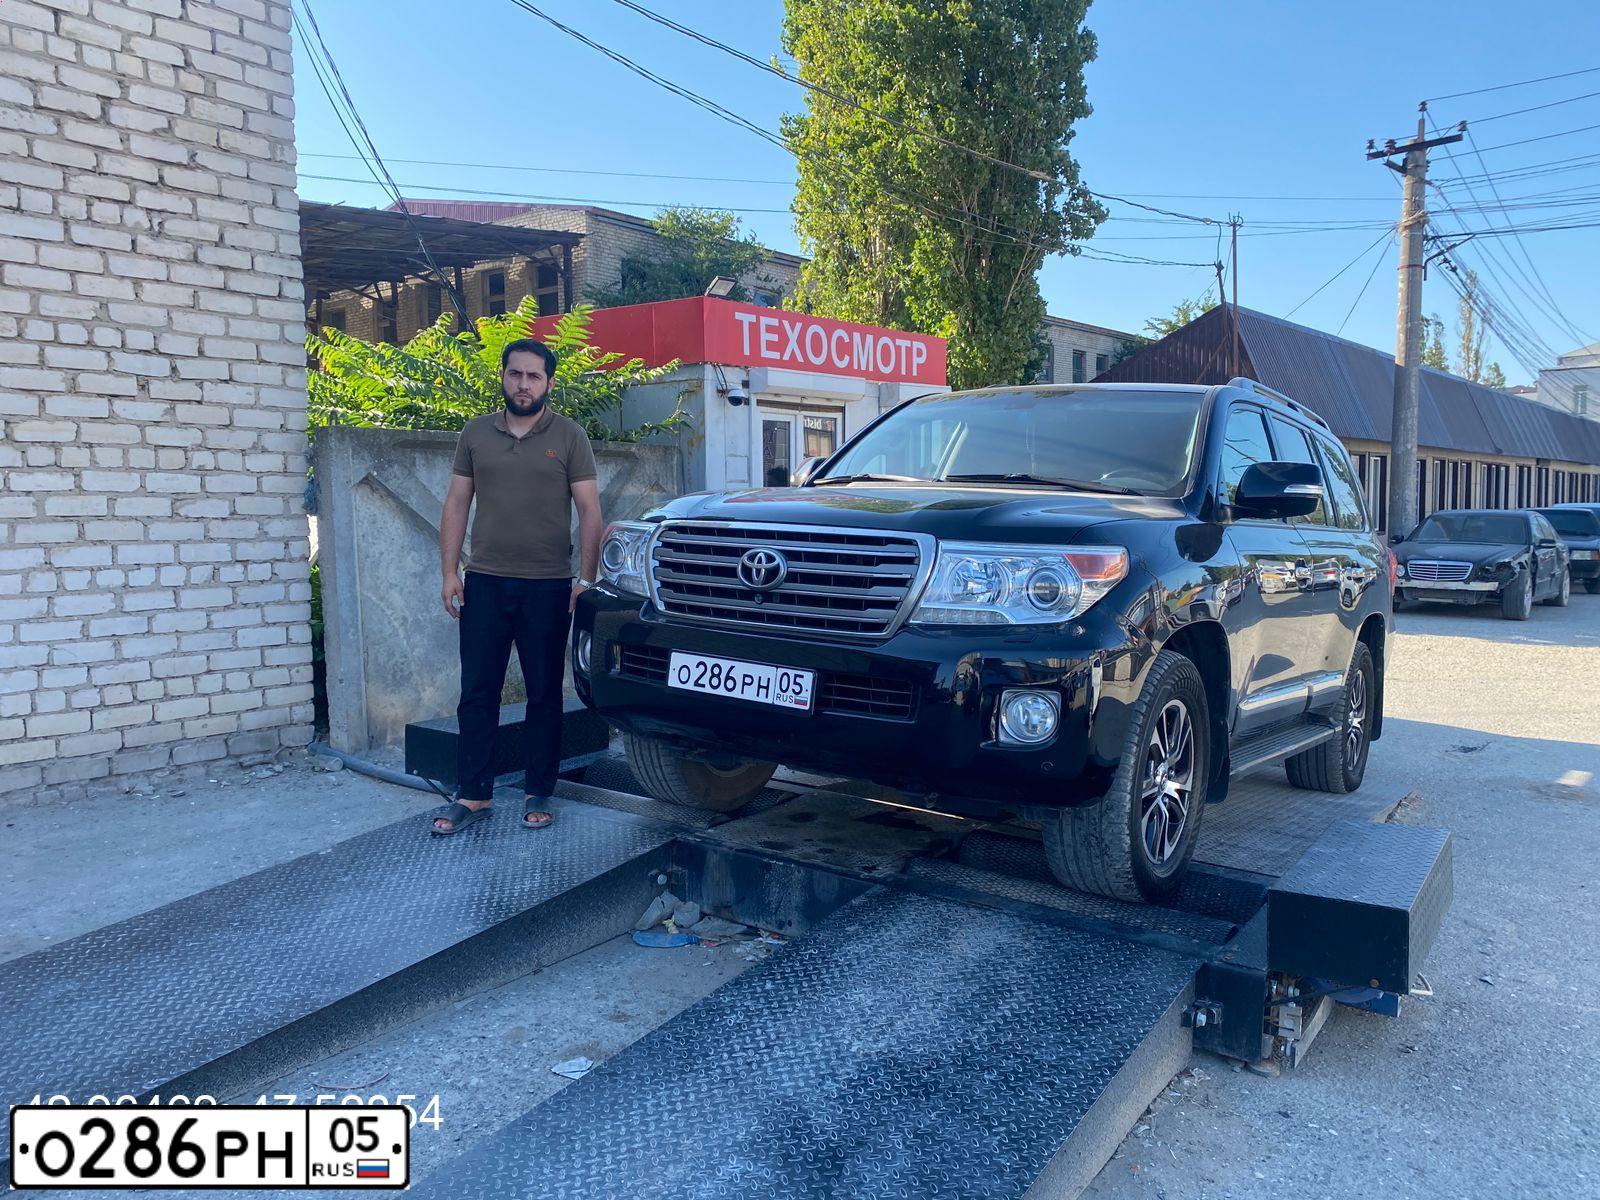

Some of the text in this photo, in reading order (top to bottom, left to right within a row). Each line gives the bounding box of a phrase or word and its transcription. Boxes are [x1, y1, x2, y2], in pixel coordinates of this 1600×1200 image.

[735, 313, 927, 376] ТЕХОСМОТР
[779, 672, 804, 695] 05
[776, 693, 794, 704] RUS
